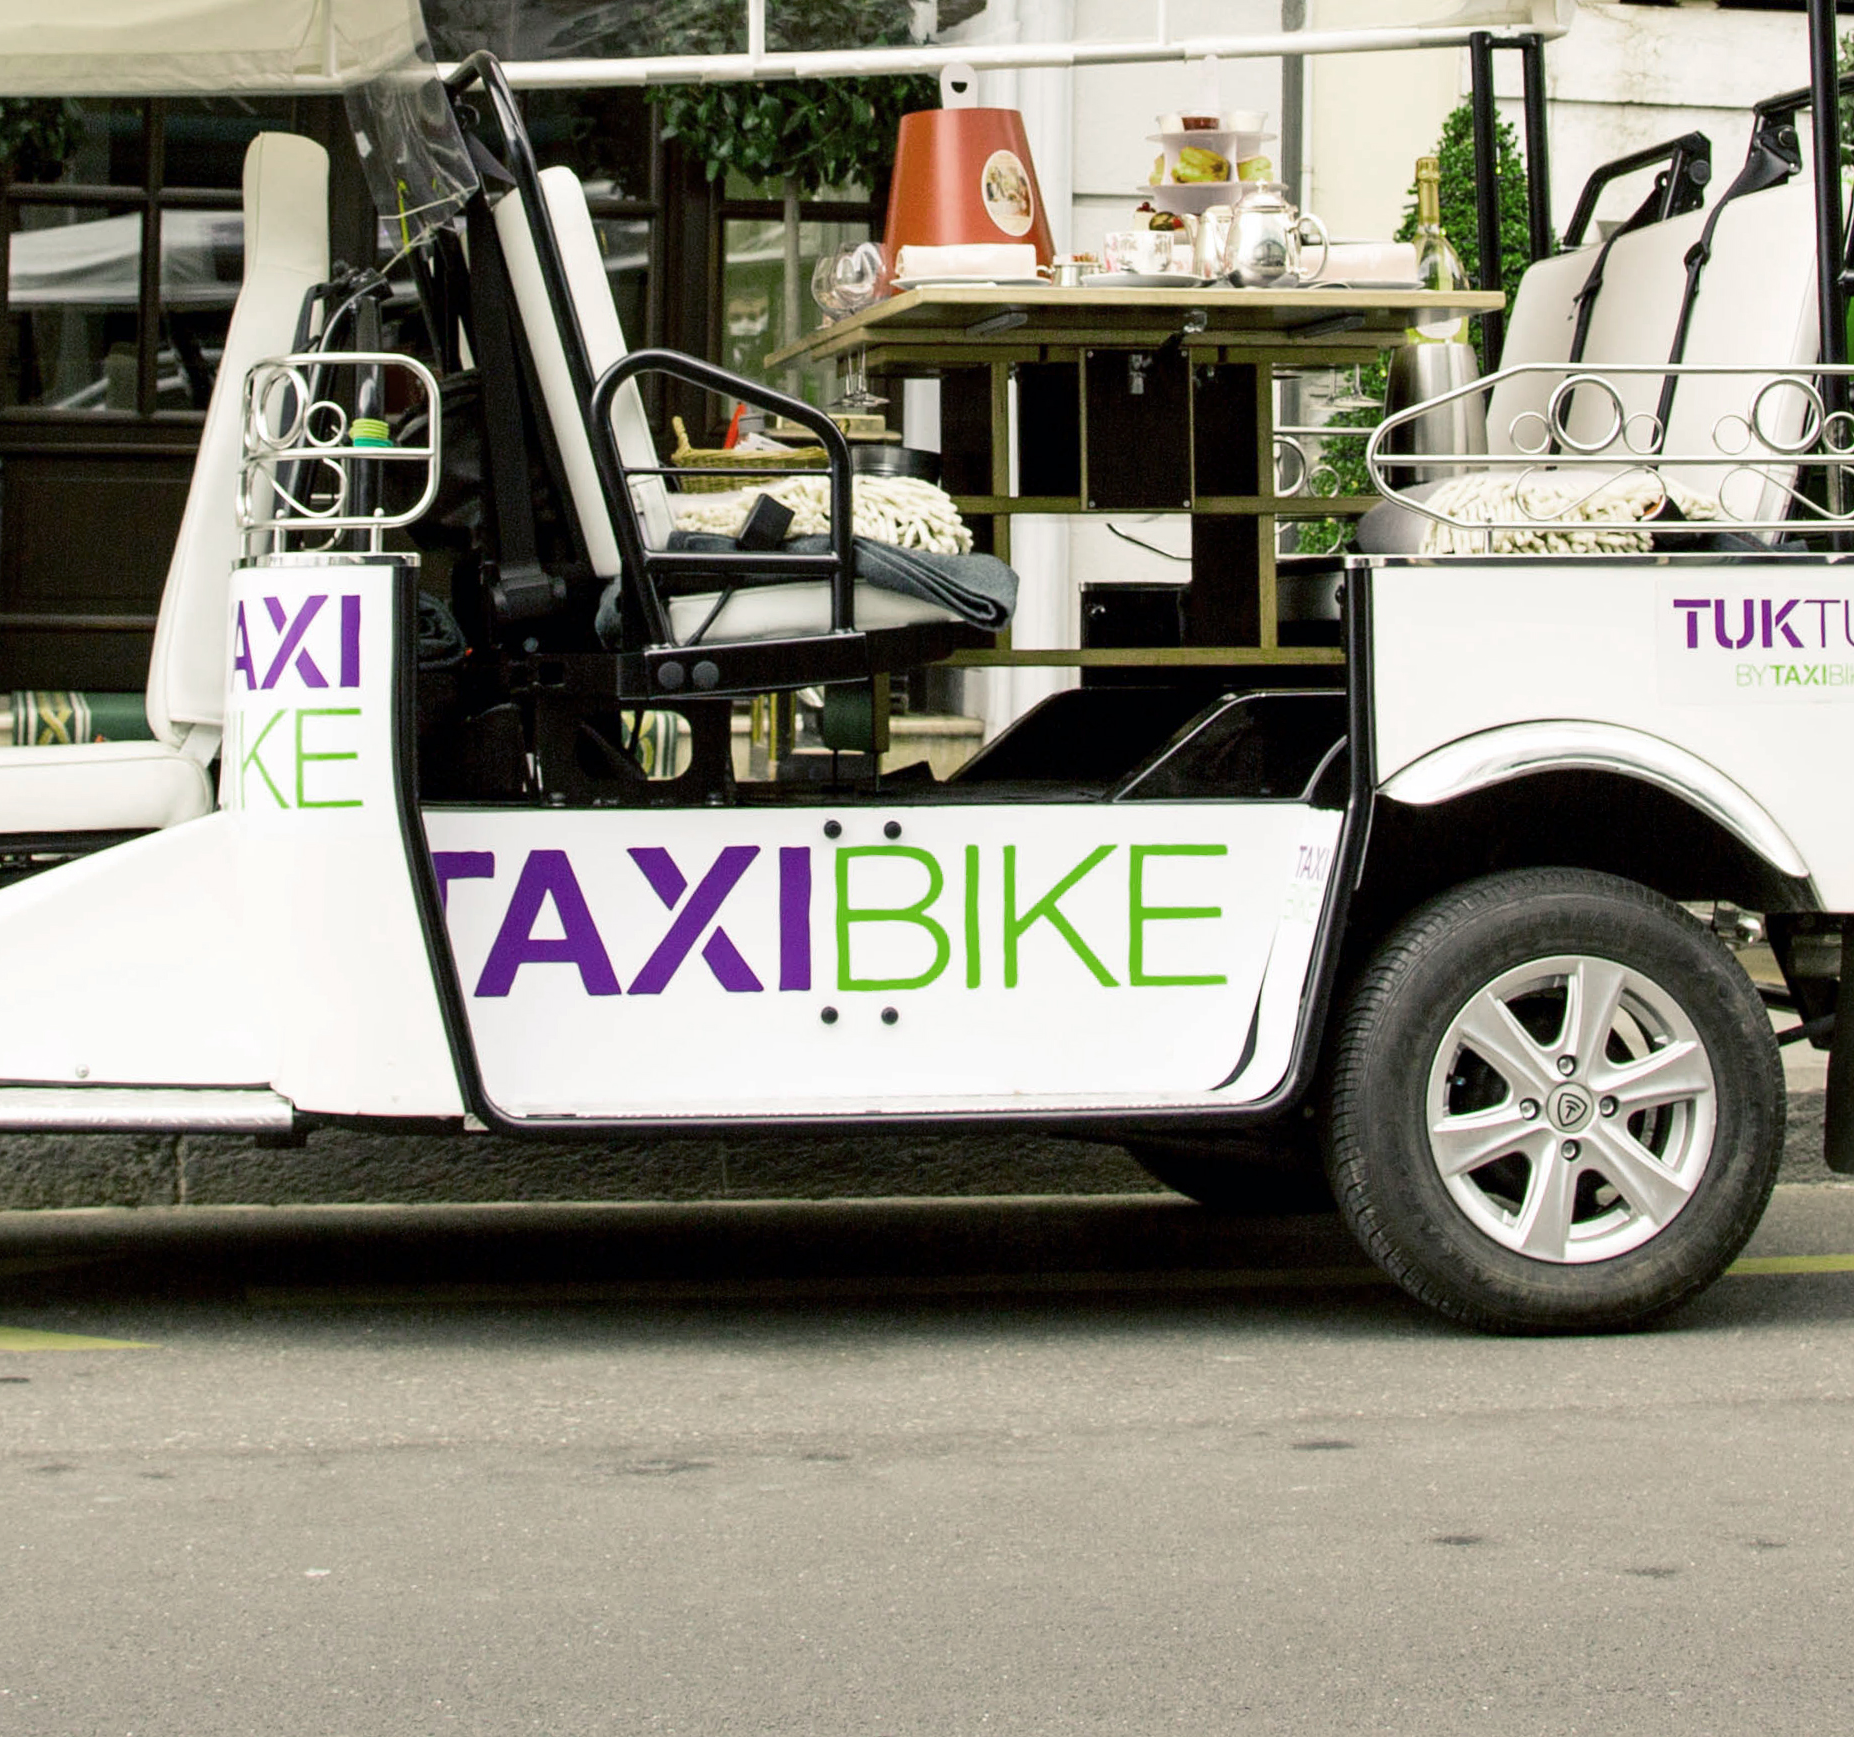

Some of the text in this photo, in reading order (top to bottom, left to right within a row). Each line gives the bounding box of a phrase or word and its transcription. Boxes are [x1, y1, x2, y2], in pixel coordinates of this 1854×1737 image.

[230, 592, 362, 691] AXI
[236, 706, 364, 811] KE
[1295, 844, 1331, 882] TAXI
